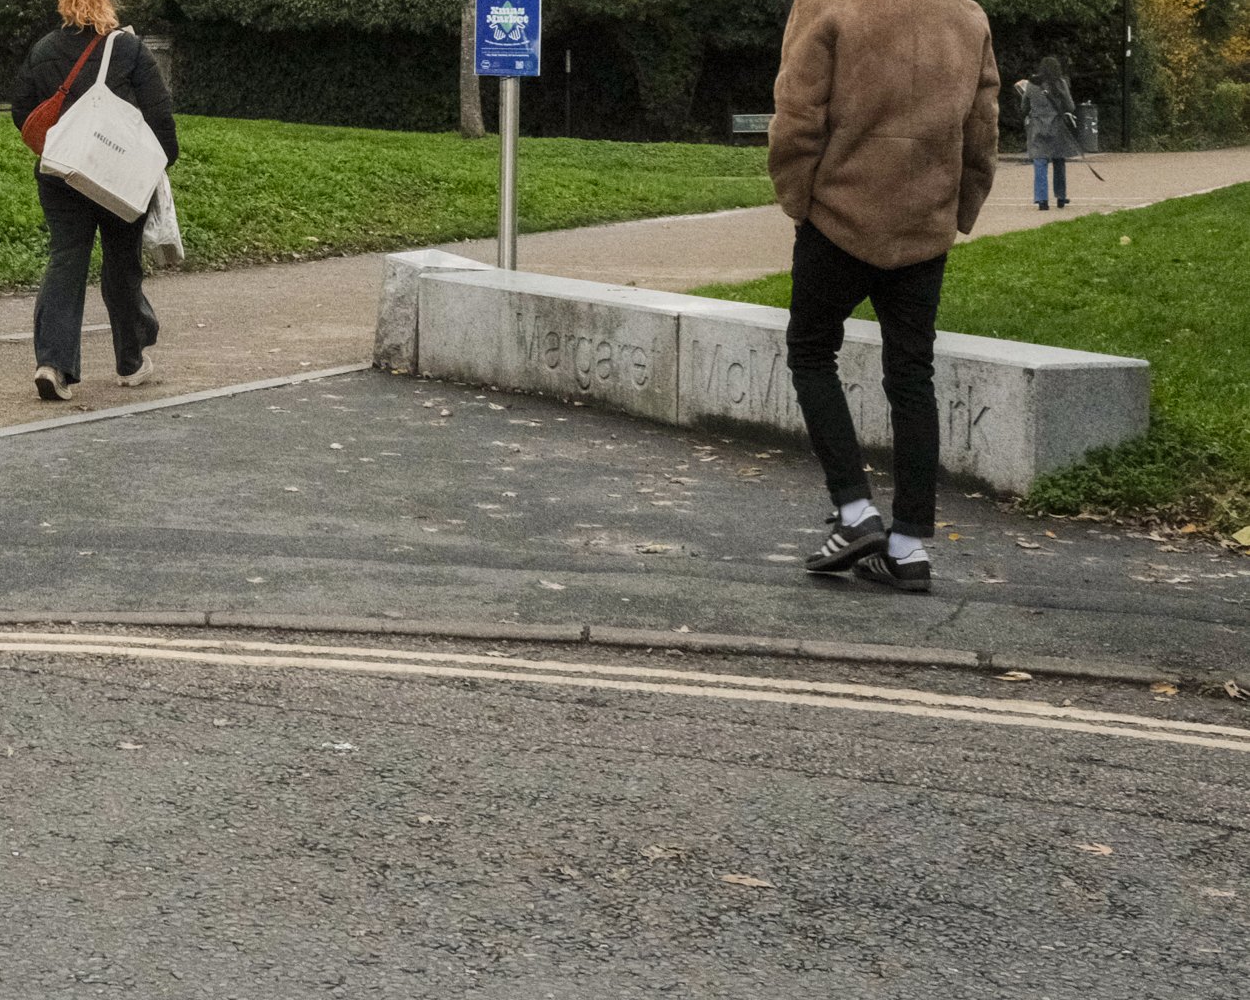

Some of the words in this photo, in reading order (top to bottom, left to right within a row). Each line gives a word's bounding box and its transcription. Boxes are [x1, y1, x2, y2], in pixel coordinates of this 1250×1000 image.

[490, 6, 525, 14] Xmas
[486, 14, 529, 24] Market
[516, 311, 661, 391] Margaret
